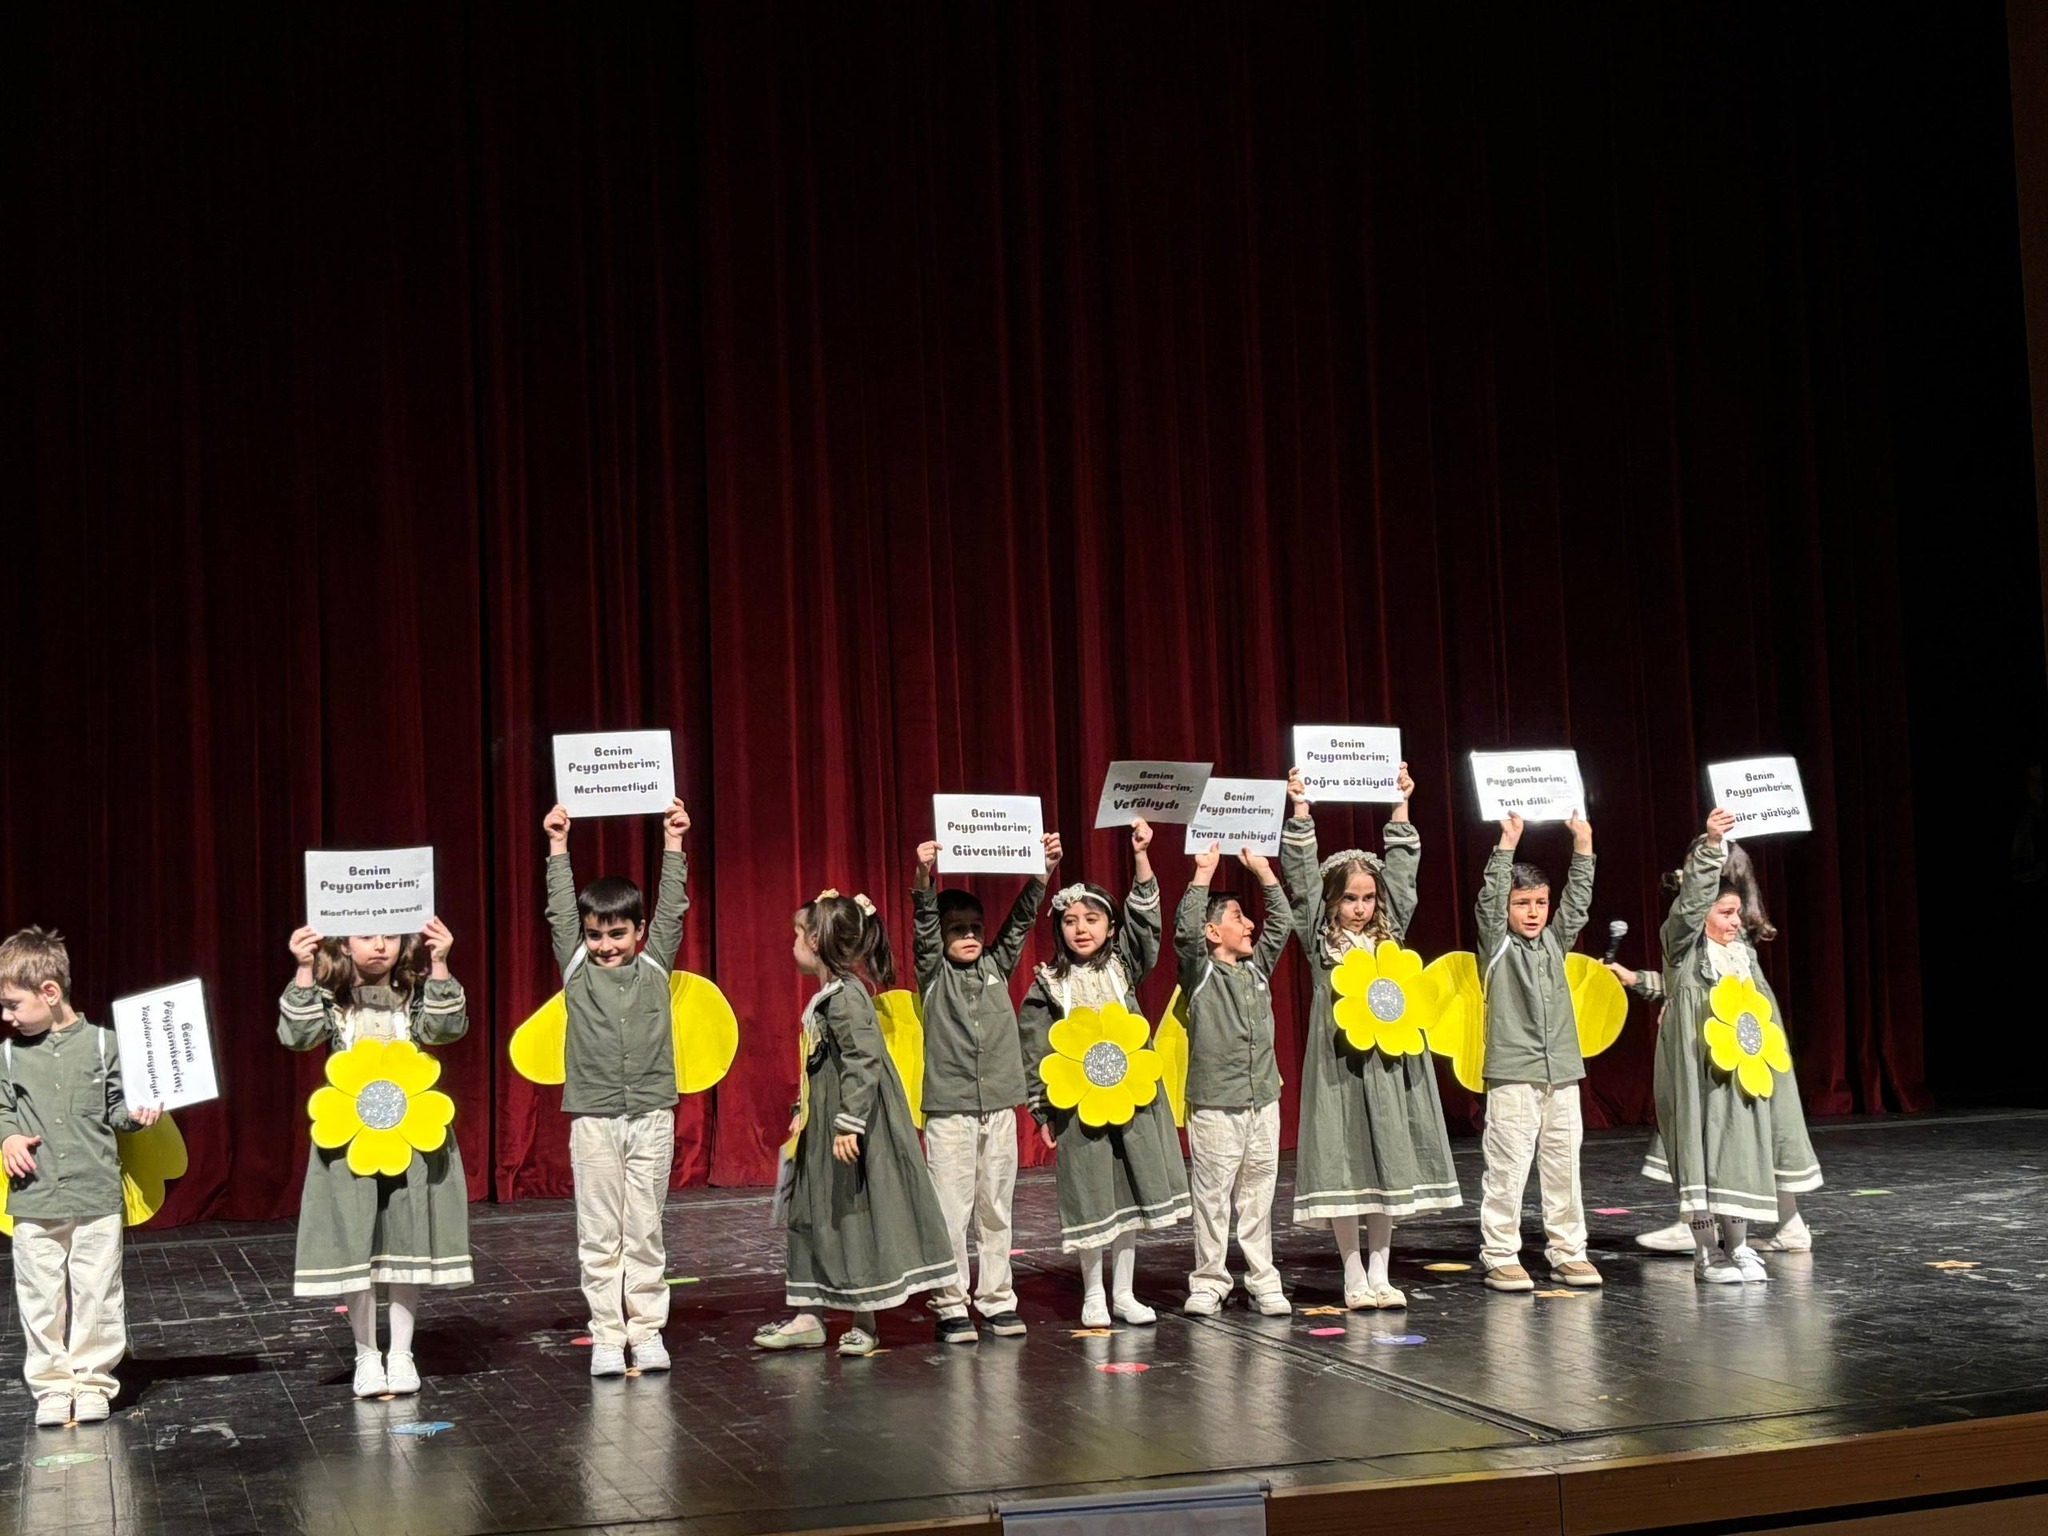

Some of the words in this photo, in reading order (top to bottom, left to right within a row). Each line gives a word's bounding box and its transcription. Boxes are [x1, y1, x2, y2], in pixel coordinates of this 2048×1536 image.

[1330, 739, 1366, 748] Benim
[594, 746, 633, 757] Benim
[1307, 751, 1390, 764] Peygamberim;
[568, 758, 661, 774] Peygamberim;
[1507, 764, 1542, 774] Benim
[1139, 771, 1174, 780] Benim
[1486, 775, 1568, 787] Peygamberim;
[1745, 770, 1775, 782] Benim
[574, 781, 659, 795] Merhametliydi
[1113, 782, 1195, 793] Peygamberim;
[1304, 776, 1340, 789] Doğru
[1343, 776, 1395, 789] sözlüydü
[1223, 791, 1255, 802] Benim
[1497, 798, 1524, 807] Tatlı
[1113, 797, 1180, 811] Vefâlıydı
[1199, 804, 1275, 817] Peygamberim;
[971, 808, 1006, 819] Benim
[1734, 812, 1758, 823] üler
[1760, 806, 1801, 821] yüzlüydü
[947, 821, 1032, 834] Peygamberim;
[1190, 829, 1226, 840] Tevazu
[1228, 829, 1278, 843] sahibiydi
[952, 844, 1032, 857] Güvenilirdi
[349, 865, 391, 876] Benim
[320, 878, 420, 894] Peygamberim;
[372, 908, 388, 918] çok
[162, 1000, 184, 1095] Peygamberim;
[181, 1022, 196, 1063] Benim
